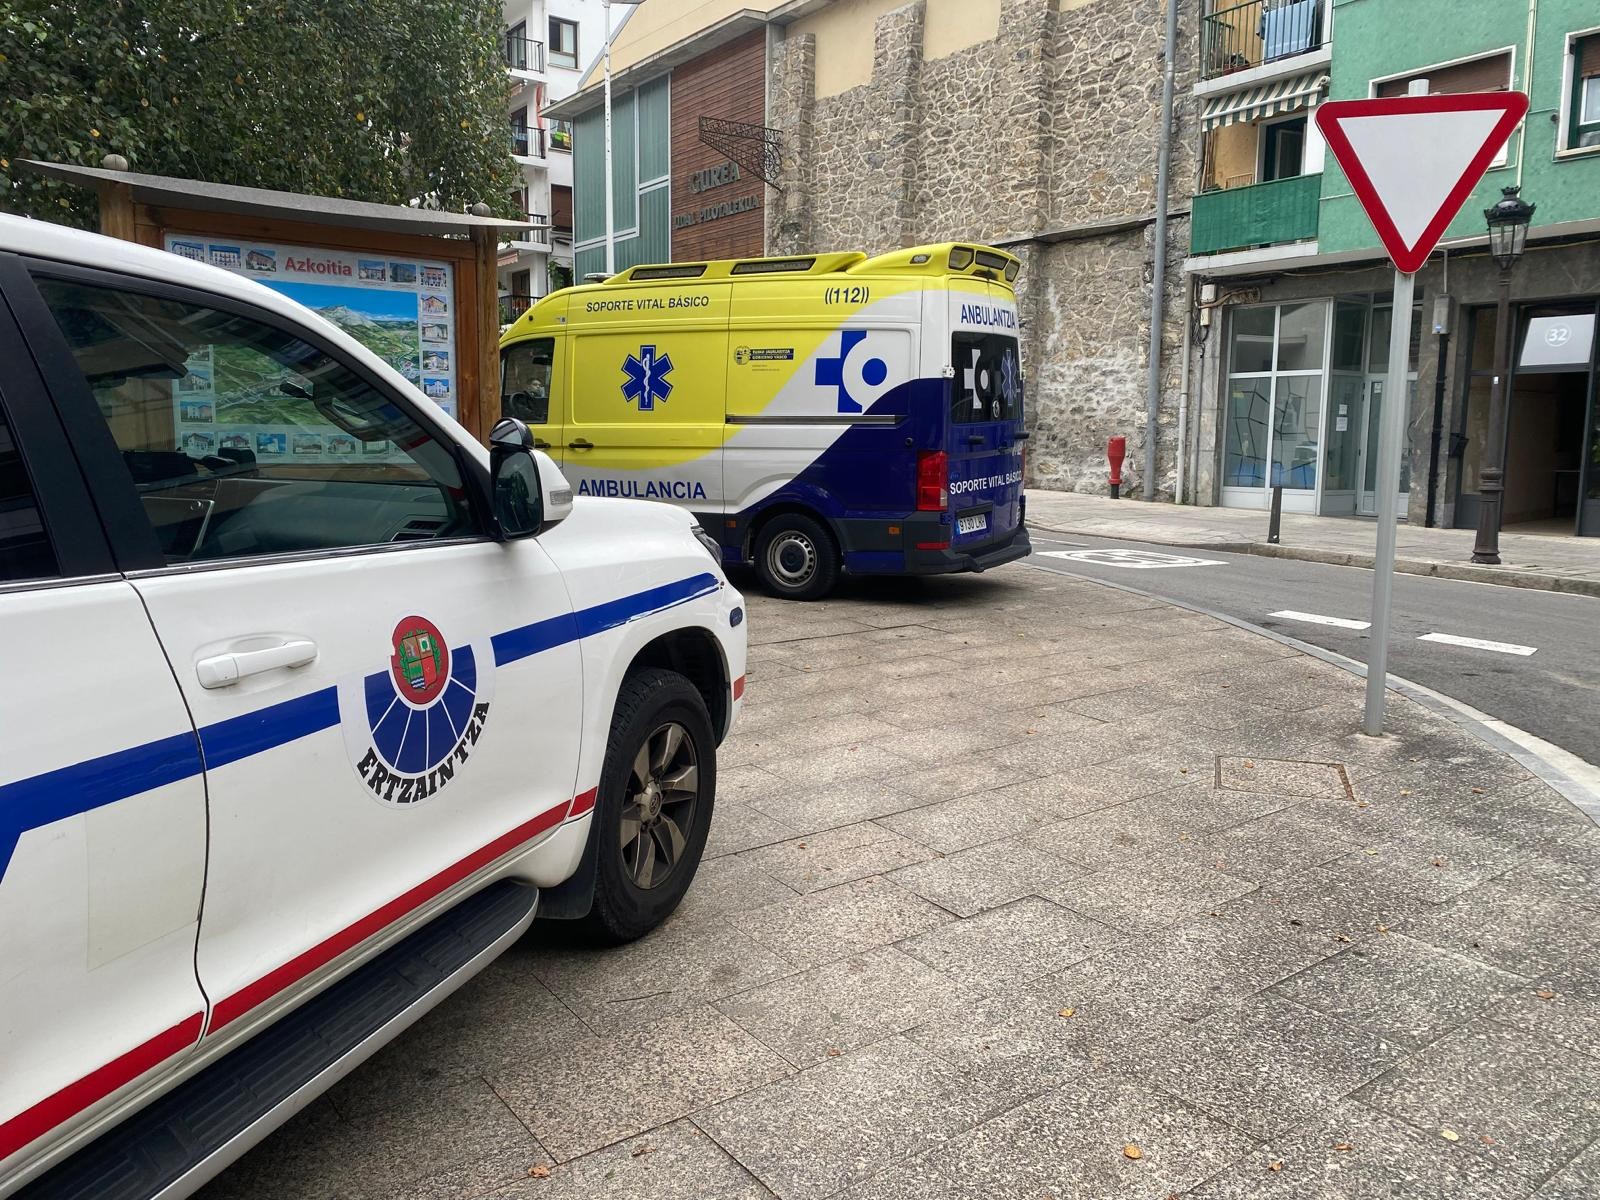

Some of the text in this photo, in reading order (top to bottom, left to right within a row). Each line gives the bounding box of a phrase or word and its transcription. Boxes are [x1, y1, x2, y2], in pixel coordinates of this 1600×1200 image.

[688, 161, 741, 194] GUREA
[284, 256, 352, 276] Azkoitia
[586, 295, 709, 313] SOPORTE VITAL BÁSICO
[960, 303, 1016, 329] ANBULANTZIA
[1548, 328, 1568, 342] 32
[578, 479, 707, 499] AMBULANCIA
[950, 477, 987, 495] SOPORTE
[988, 475, 1005, 488] VITAL
[356, 701, 490, 804] ERTZAINTZA
